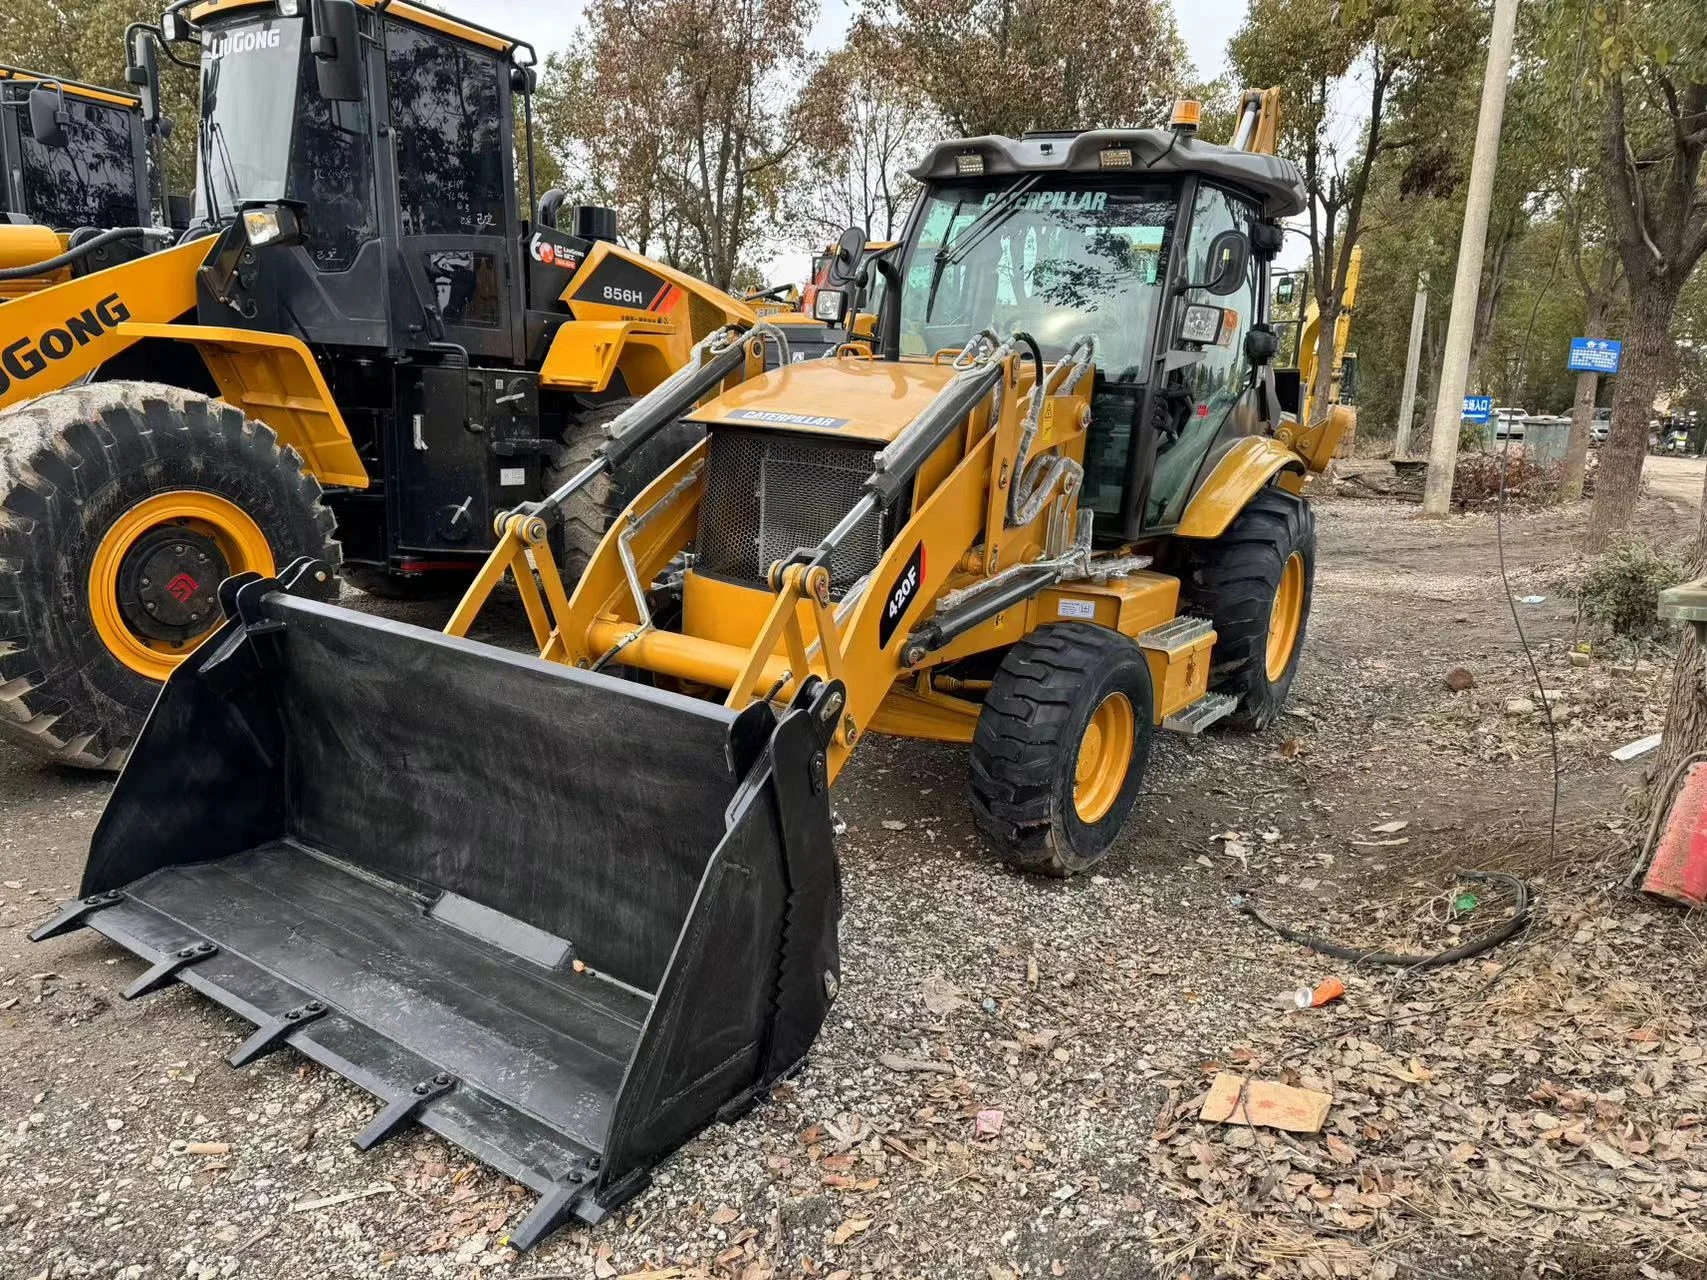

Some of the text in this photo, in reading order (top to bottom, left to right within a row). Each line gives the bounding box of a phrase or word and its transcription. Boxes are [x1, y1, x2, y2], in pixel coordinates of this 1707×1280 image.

[603, 286, 642, 304] 856H
[742, 411, 833, 425] CATERPILLAR
[889, 565, 916, 618] 420F
